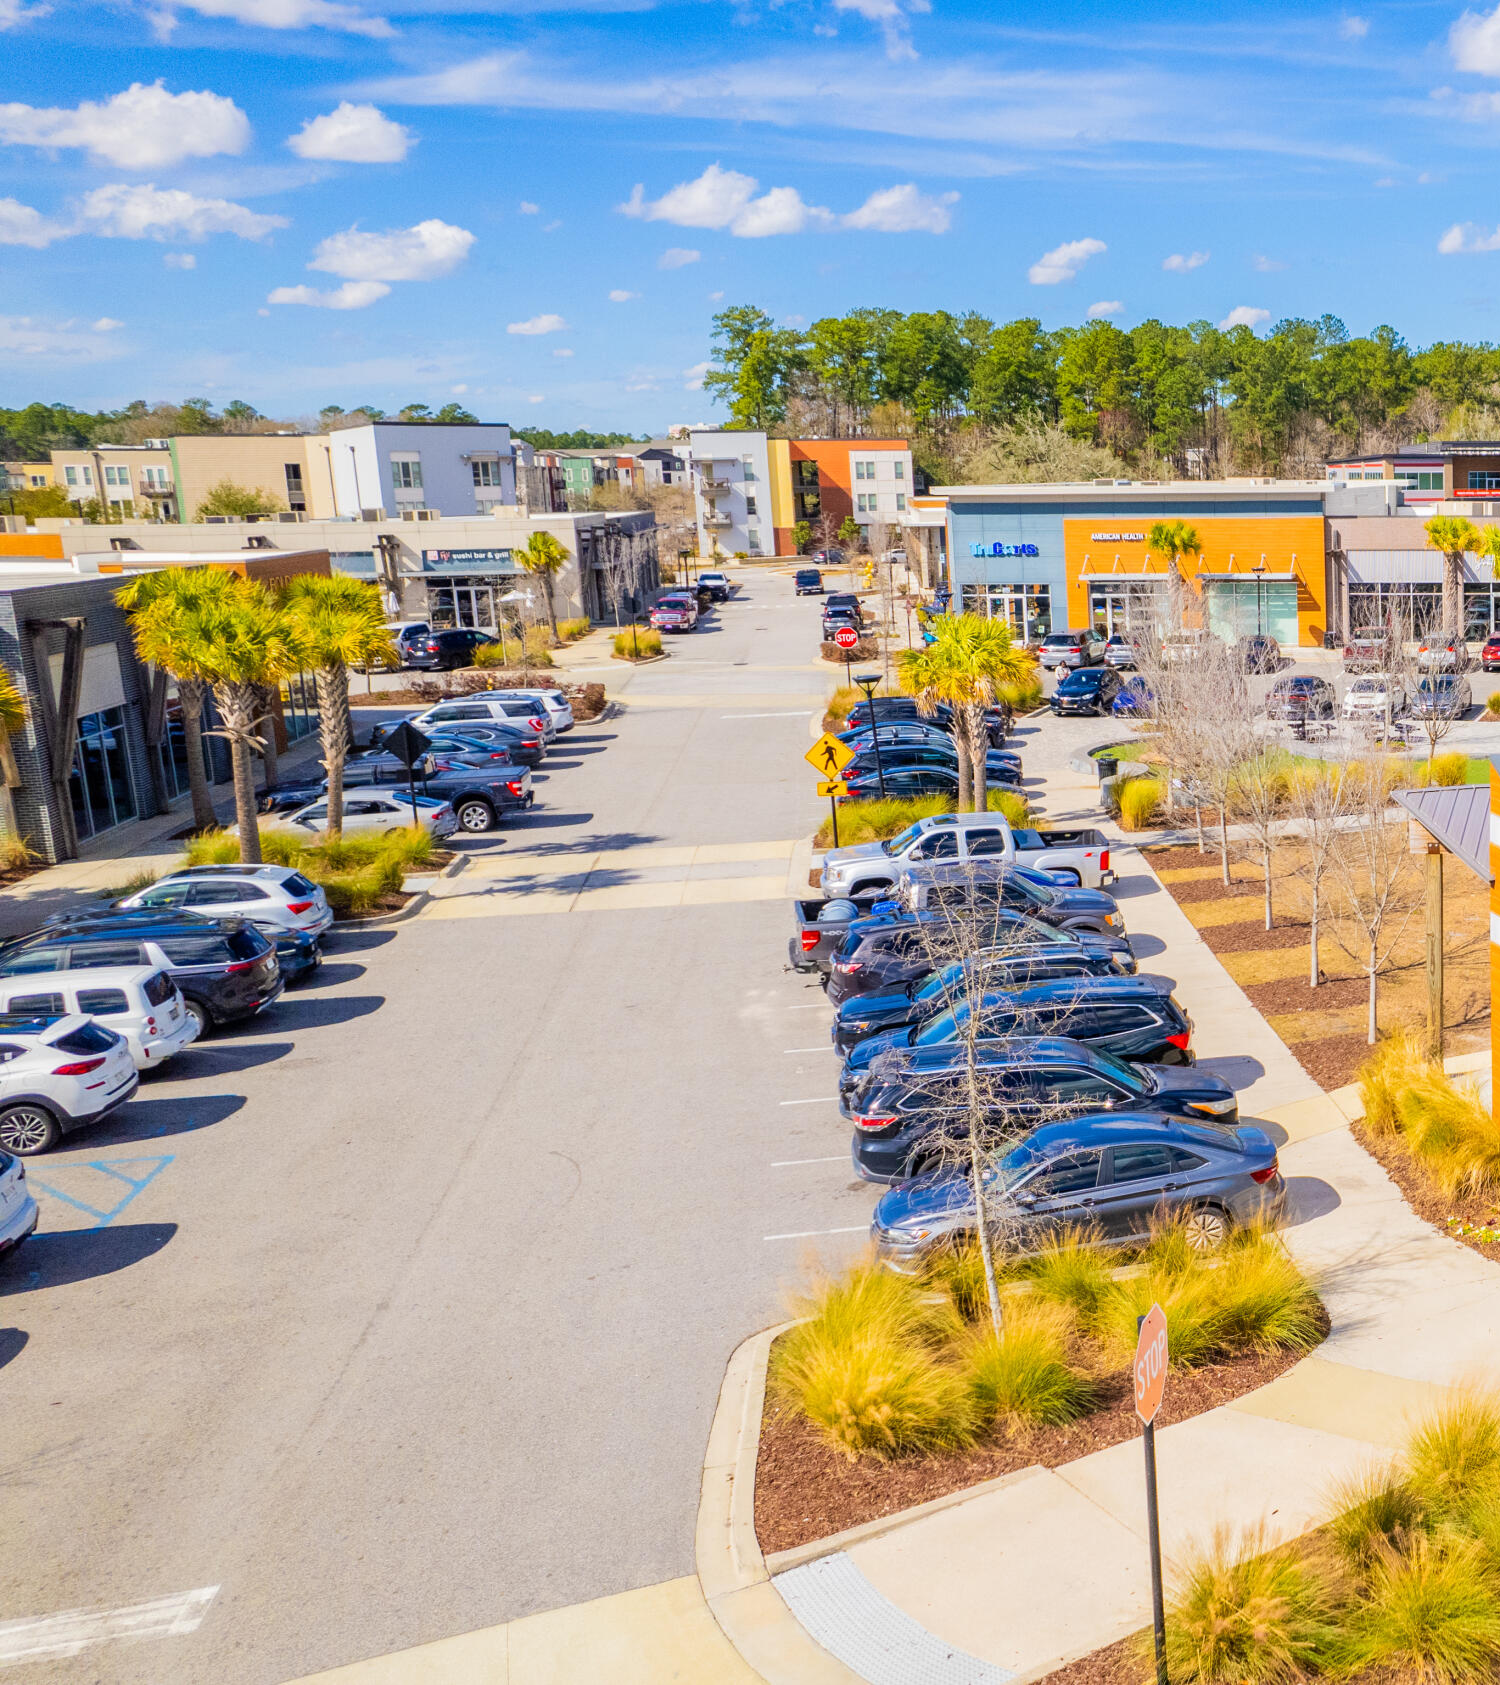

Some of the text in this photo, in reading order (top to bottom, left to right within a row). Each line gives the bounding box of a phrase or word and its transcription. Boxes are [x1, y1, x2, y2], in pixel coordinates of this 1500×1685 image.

[487, 551, 494, 559] &
[495, 551, 509, 559] grill
[837, 634, 856, 642] STOP
[1137, 1329, 1166, 1400] STOP
